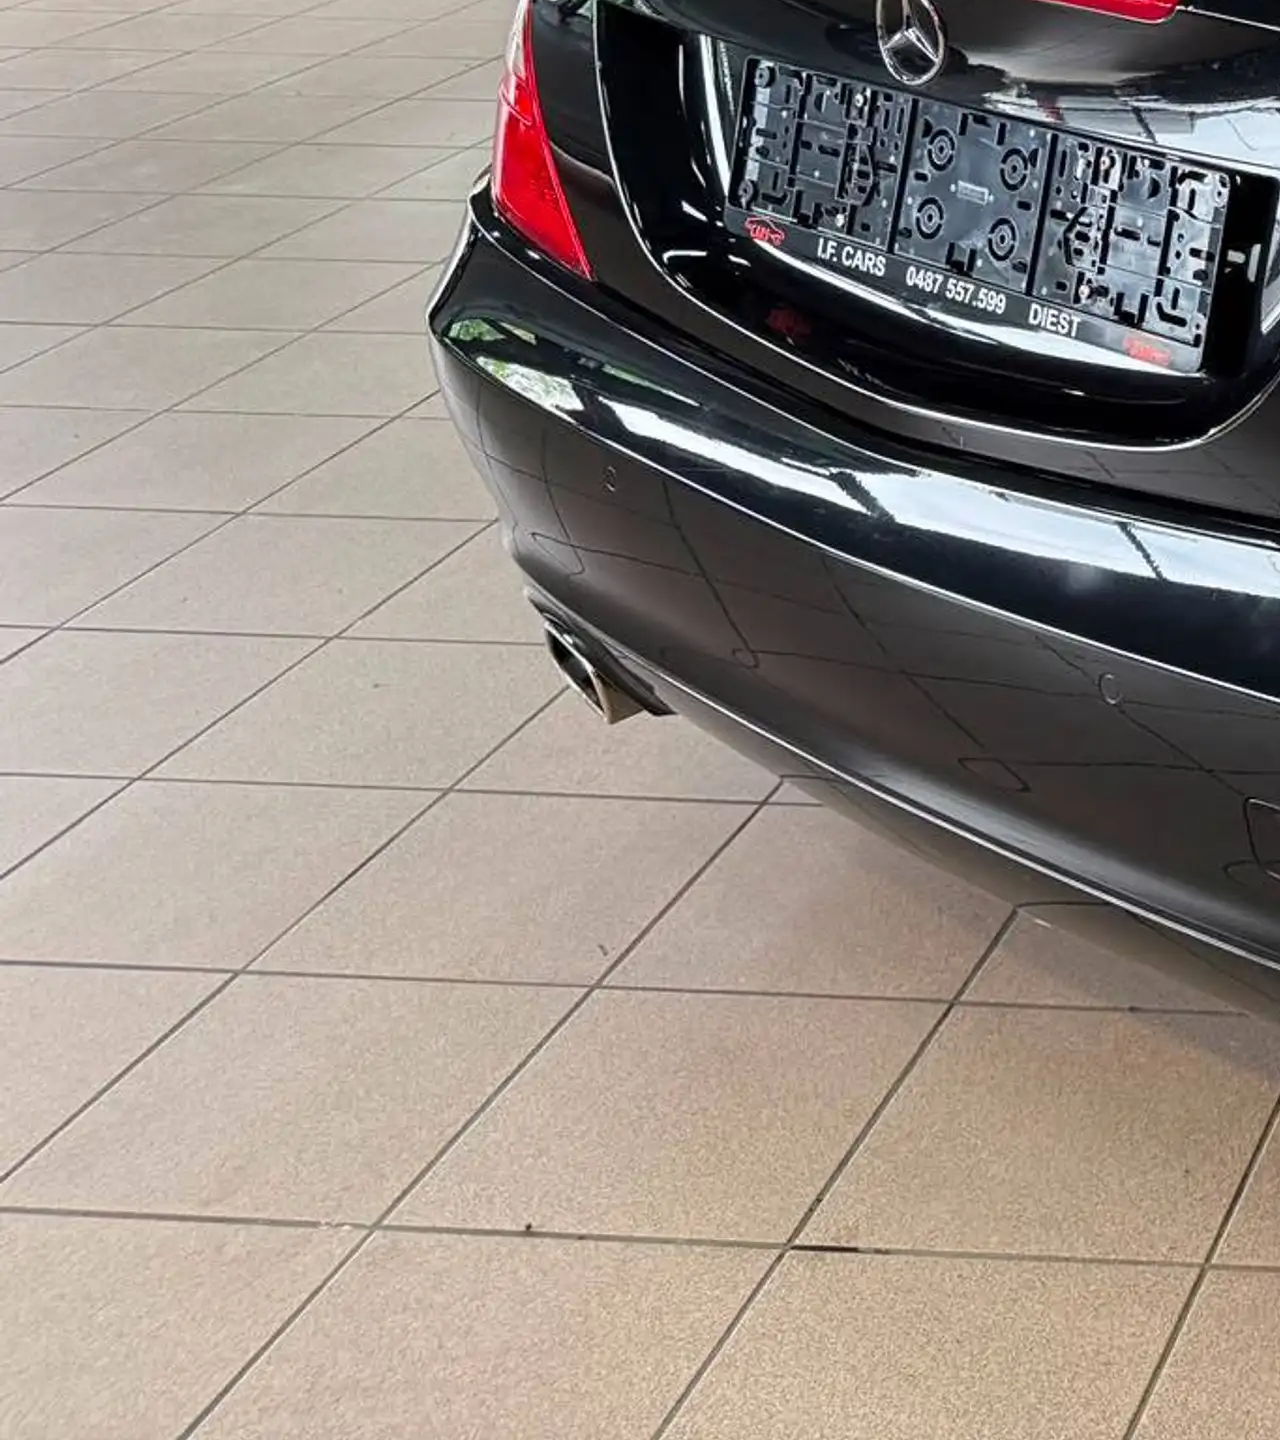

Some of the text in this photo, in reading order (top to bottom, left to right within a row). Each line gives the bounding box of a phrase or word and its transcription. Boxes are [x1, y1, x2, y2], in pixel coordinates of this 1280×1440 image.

[842, 247, 887, 277] CARS
[905, 265, 943, 294] 0487
[944, 279, 1007, 315] 557.599
[1027, 302, 1082, 338] DIEST
